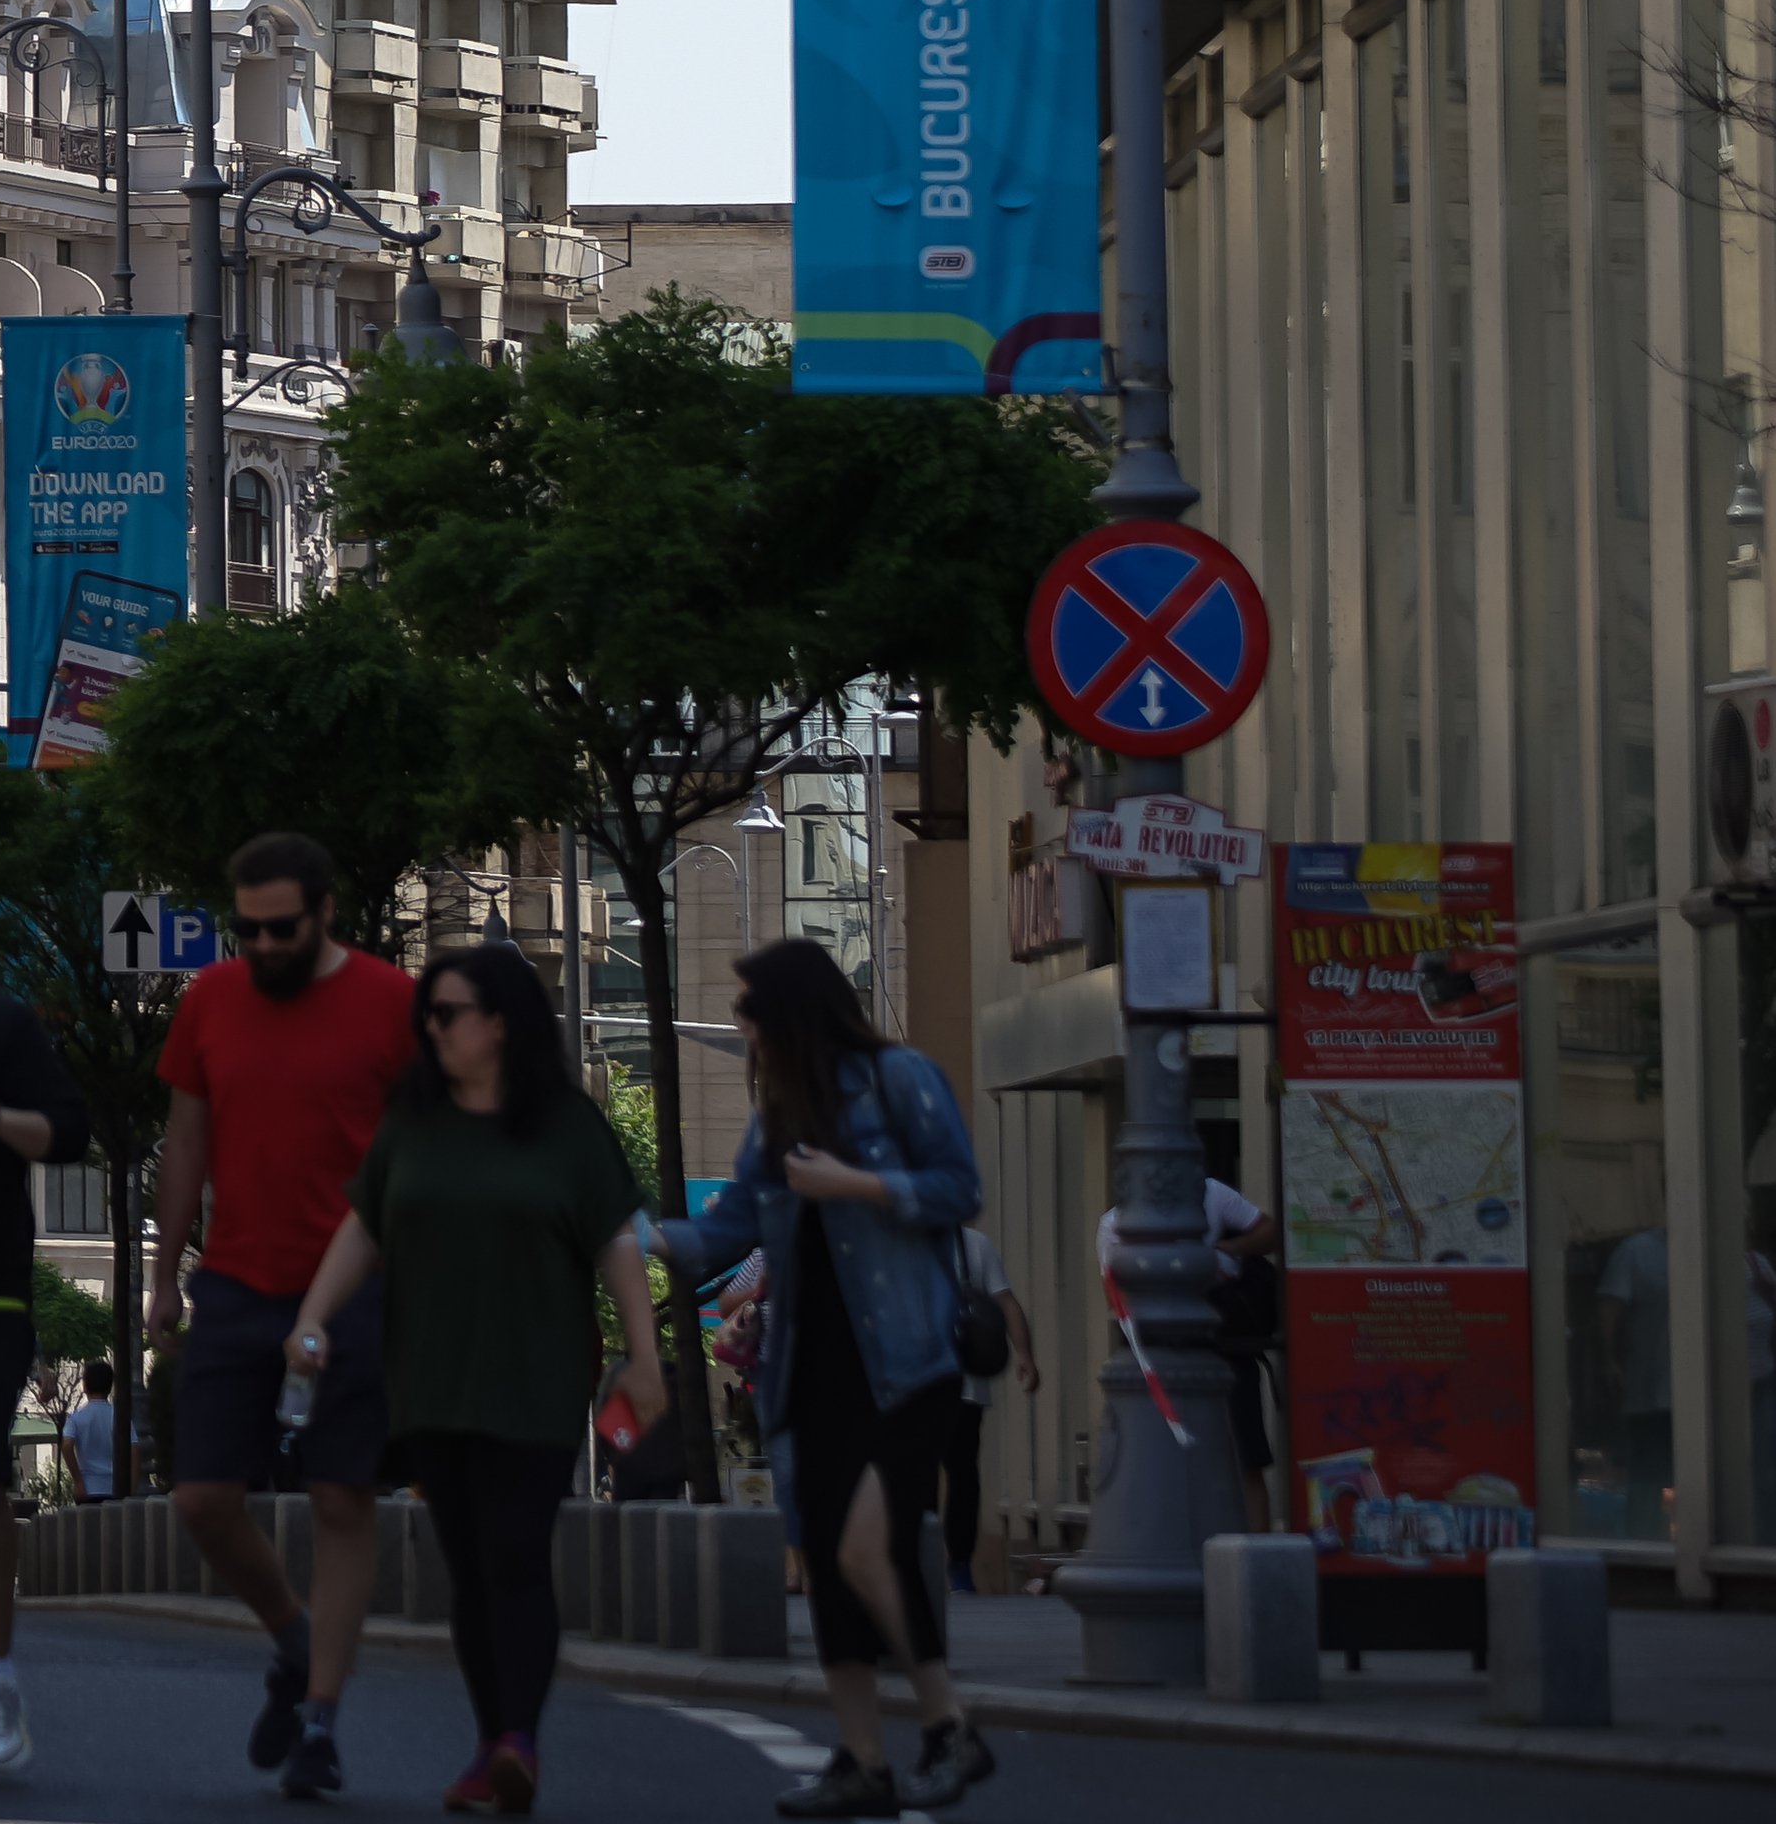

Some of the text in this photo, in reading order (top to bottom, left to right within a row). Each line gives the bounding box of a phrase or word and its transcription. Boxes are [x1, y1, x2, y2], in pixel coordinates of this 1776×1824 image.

[51, 436, 137, 450] EURO2020
[29, 472, 165, 496] DOWNLOAD
[29, 501, 128, 524] THE APP
[81, 590, 149, 617] YOUR GUIDE
[174, 916, 202, 956] P
[1290, 908, 1498, 966] BUCHAREST
[1307, 960, 1425, 997] city tour
[1306, 1030, 1327, 1047] 12
